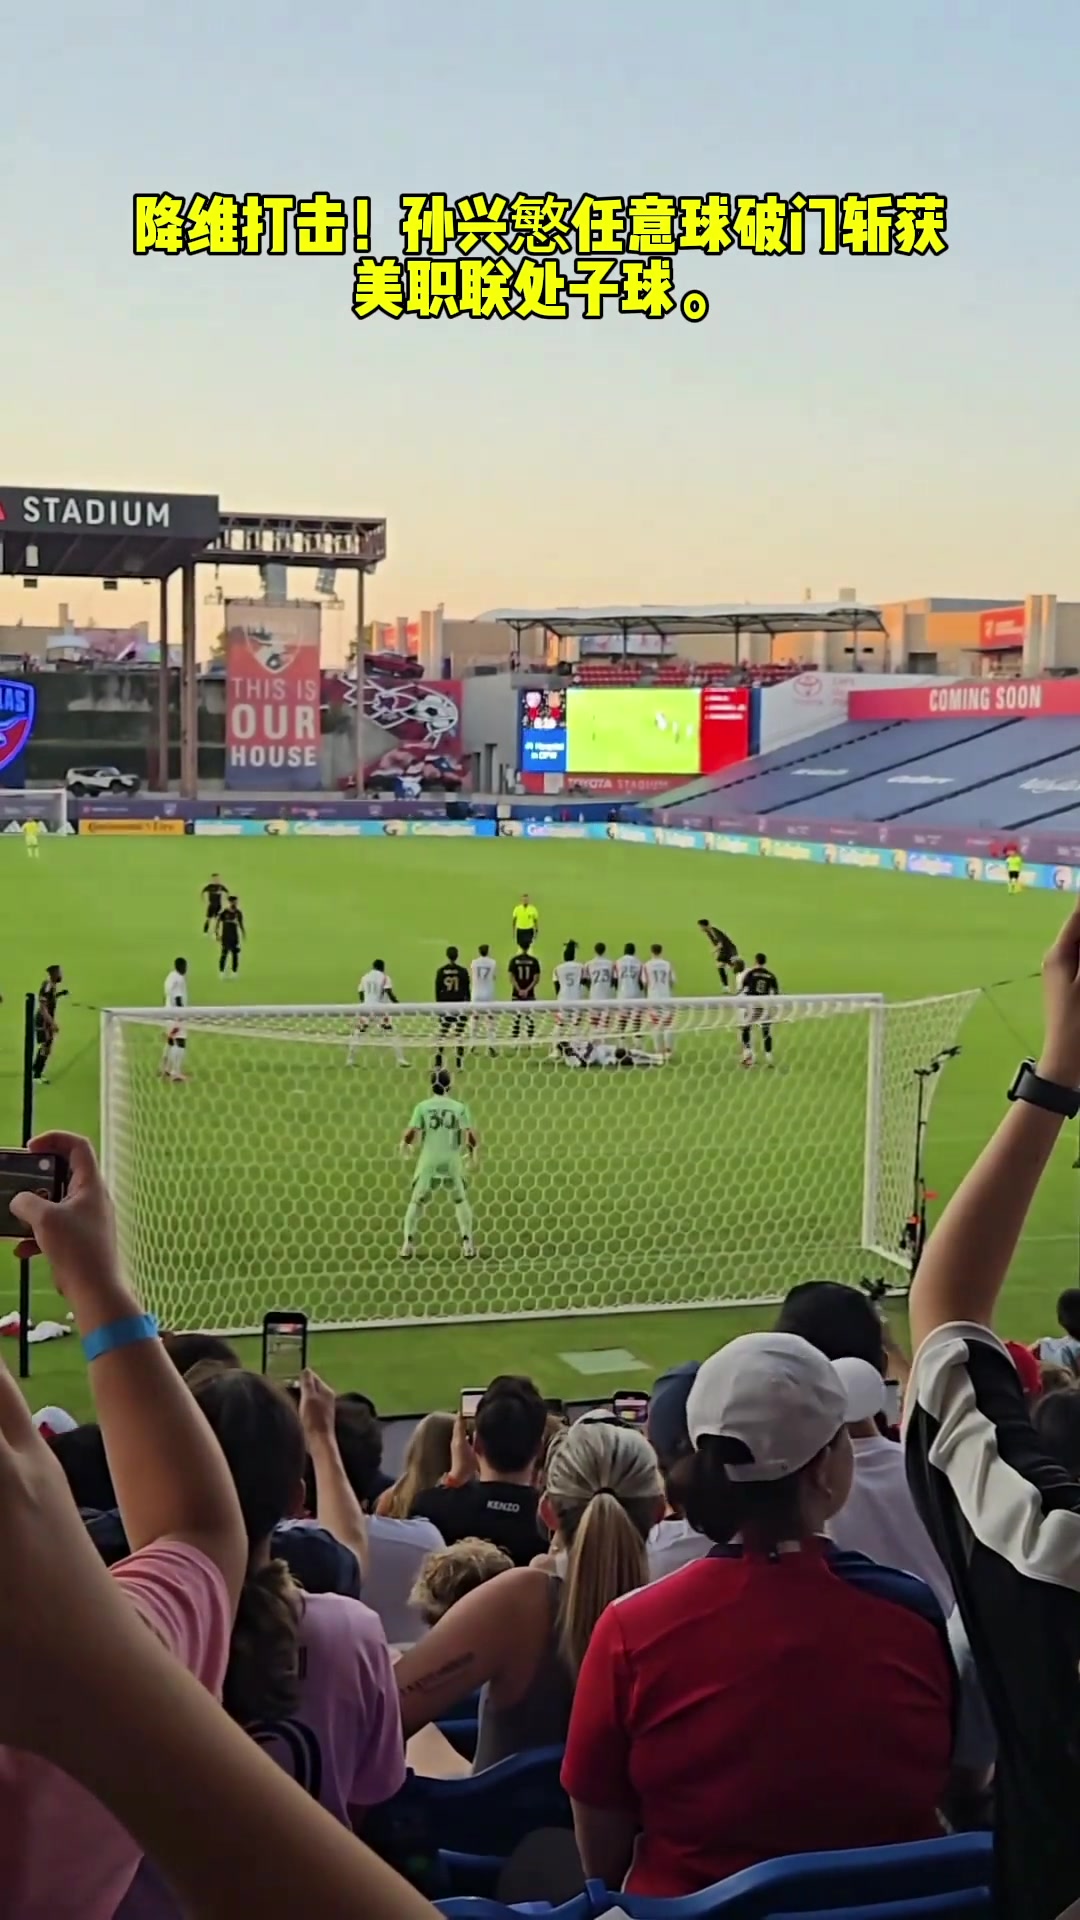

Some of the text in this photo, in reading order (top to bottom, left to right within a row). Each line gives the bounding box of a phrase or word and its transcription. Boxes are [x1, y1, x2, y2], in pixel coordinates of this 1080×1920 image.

[23, 496, 170, 528] STADIUM
[232, 678, 317, 701] THIS IS
[929, 684, 1042, 712] COMING SOON
[231, 703, 316, 740] OUR
[230, 745, 317, 767] HOUSE
[477, 966, 491, 979] 17
[517, 965, 531, 980] 11
[565, 972, 575, 987] 5
[593, 968, 610, 984] 23
[443, 976, 460, 992] 91
[428, 1108, 456, 1130] 30
[486, 1500, 521, 1512] KENZO
